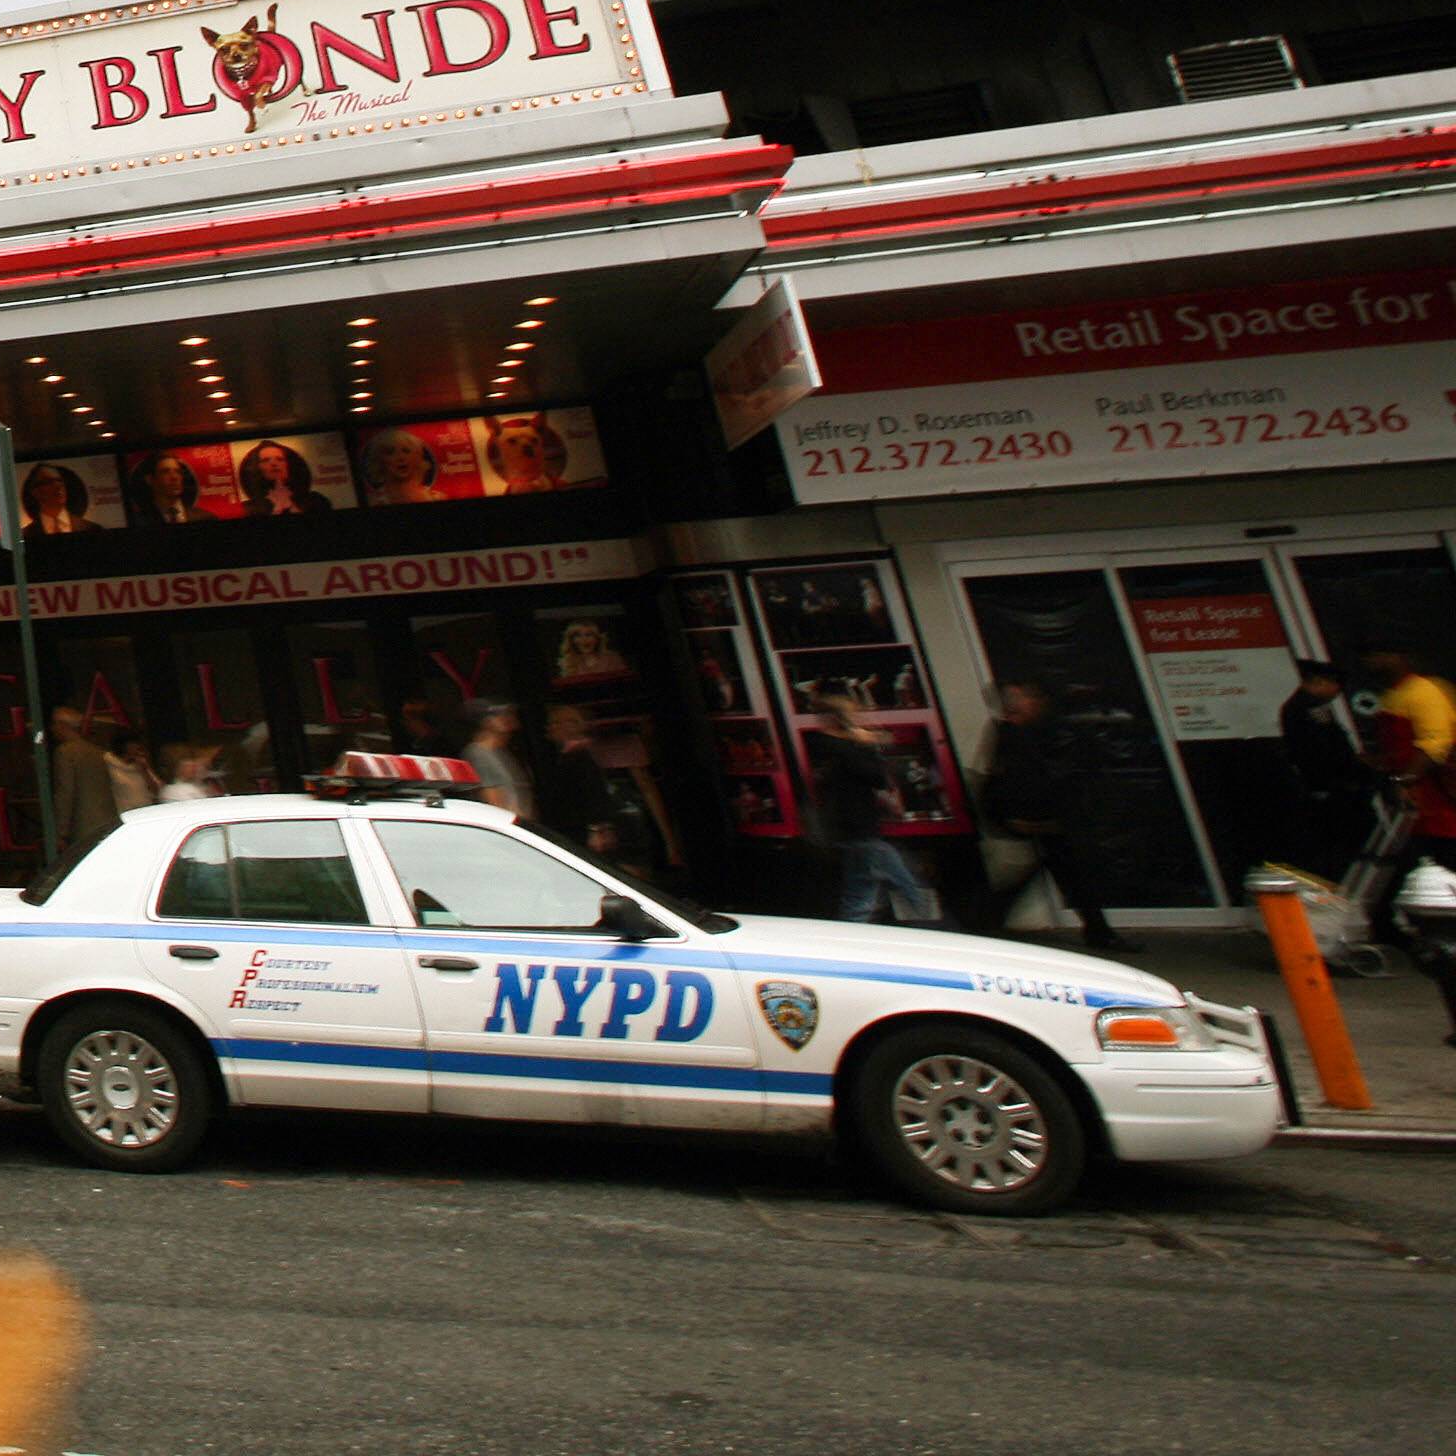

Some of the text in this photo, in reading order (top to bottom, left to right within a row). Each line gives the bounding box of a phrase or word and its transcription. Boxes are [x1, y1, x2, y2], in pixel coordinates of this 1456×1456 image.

[332, 84, 410, 120] Musical
[1015, 278, 1435, 359] Retail Space for
[794, 380, 1287, 446] Jeffrey Roseman Paul Berkman
[801, 401, 1412, 478] 212.372.2430 212.372.2436
[94, 560, 309, 612] MUSICAL
[484, 962, 717, 1044] NYPD
[977, 971, 1084, 1007] POLICE
